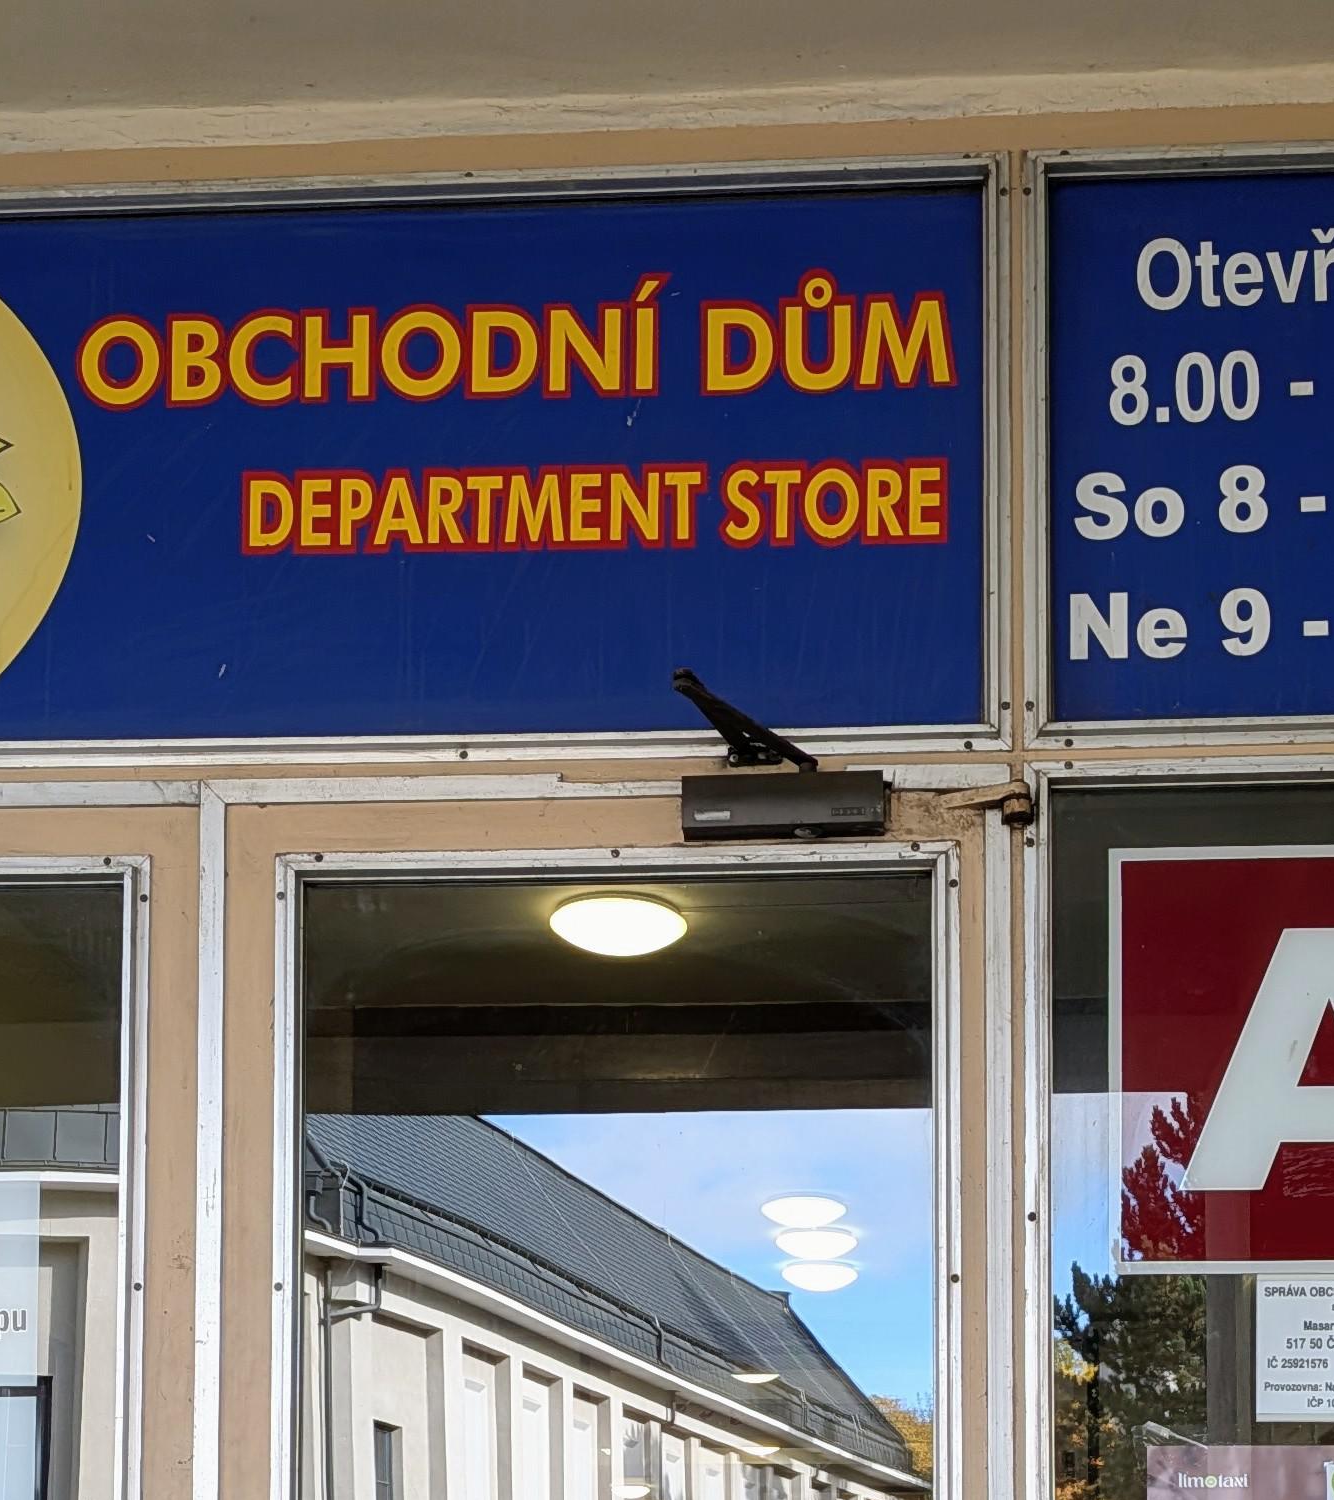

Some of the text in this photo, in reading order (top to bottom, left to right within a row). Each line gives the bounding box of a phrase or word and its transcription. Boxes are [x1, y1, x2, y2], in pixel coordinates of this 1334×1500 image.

[76, 269, 958, 409] OBCHODNÍ DŮM
[1109, 350, 1260, 426] 8.00
[242, 458, 947, 555] DEPARTMENT STORE
[1074, 472, 1185, 541] So
[1218, 465, 1268, 534] 8
[1069, 592, 1188, 661] Ne
[1220, 587, 1270, 657] 9
[1264, 1284, 1307, 1297] SPRÁVA
[1267, 1356, 1278, 1368] IČ
[1286, 1338, 1305, 1349] 517
[1310, 1338, 1323, 1349] 50
[1264, 1382, 1322, 1392] Provozovna:
